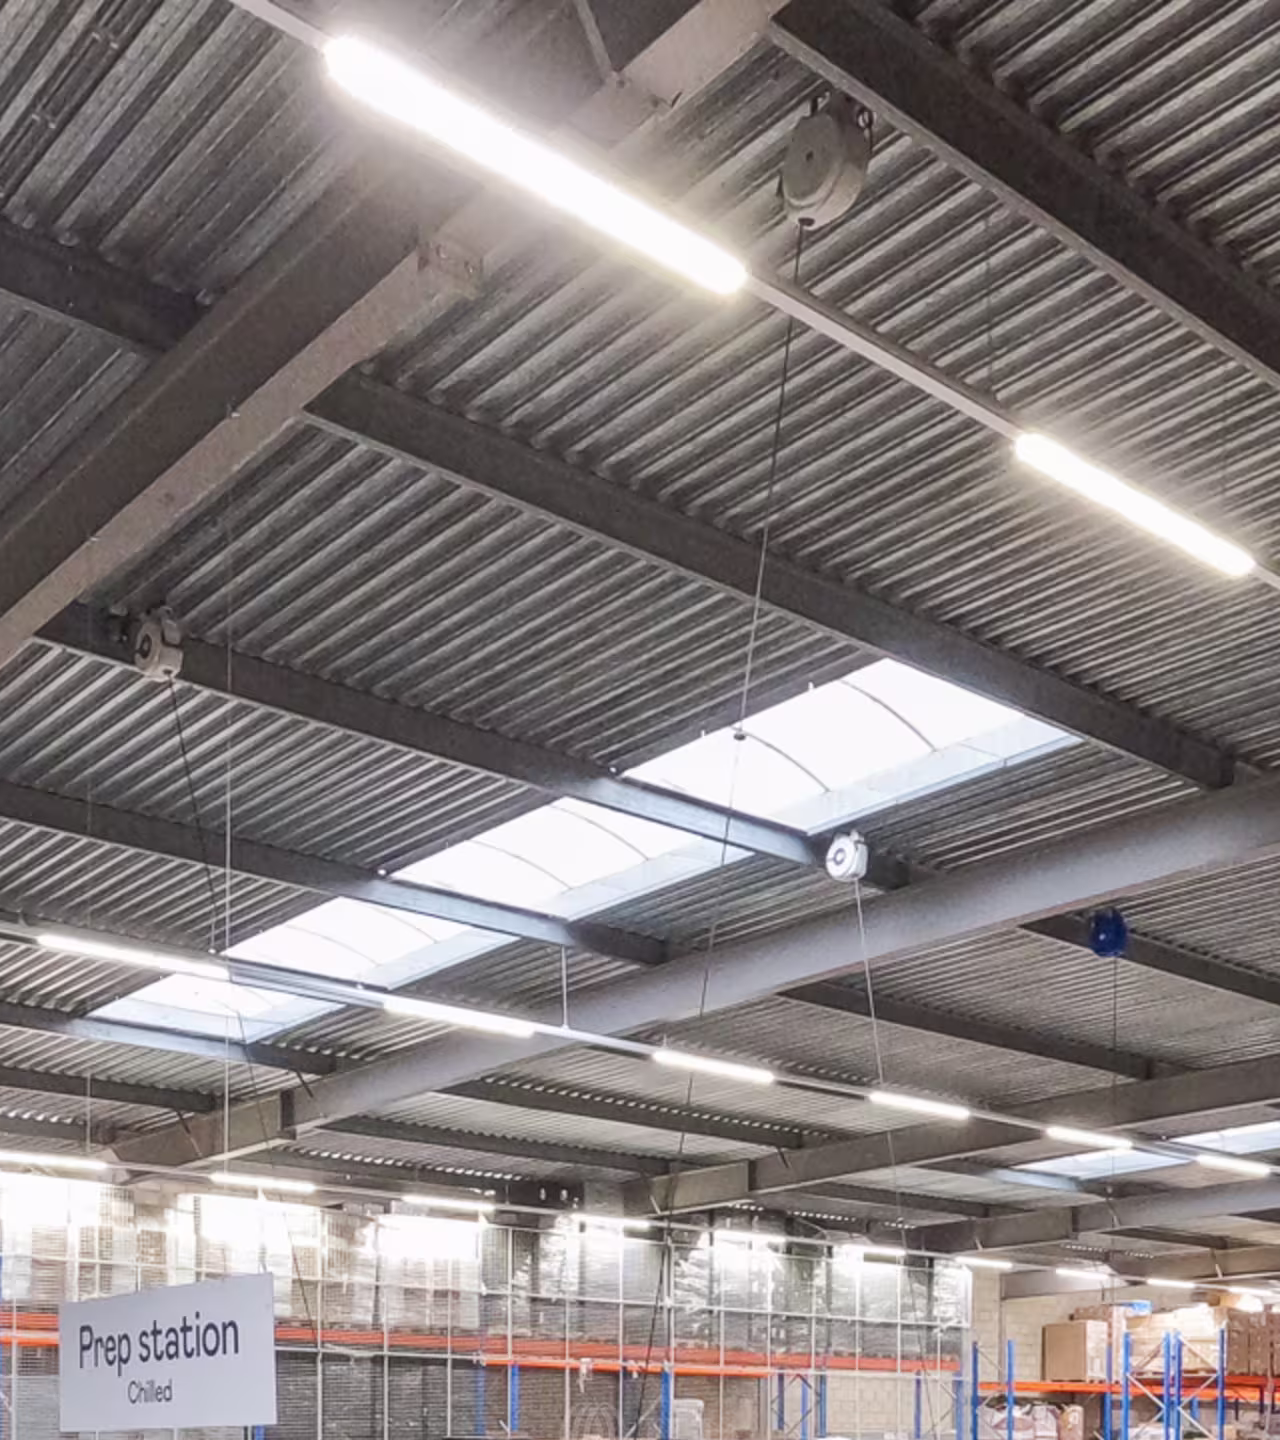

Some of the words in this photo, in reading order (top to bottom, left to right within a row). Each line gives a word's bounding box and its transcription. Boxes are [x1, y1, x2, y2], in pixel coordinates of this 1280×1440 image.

[79, 1325, 131, 1377] Prep
[138, 1311, 239, 1363] station
[127, 1379, 173, 1404] Chilled
